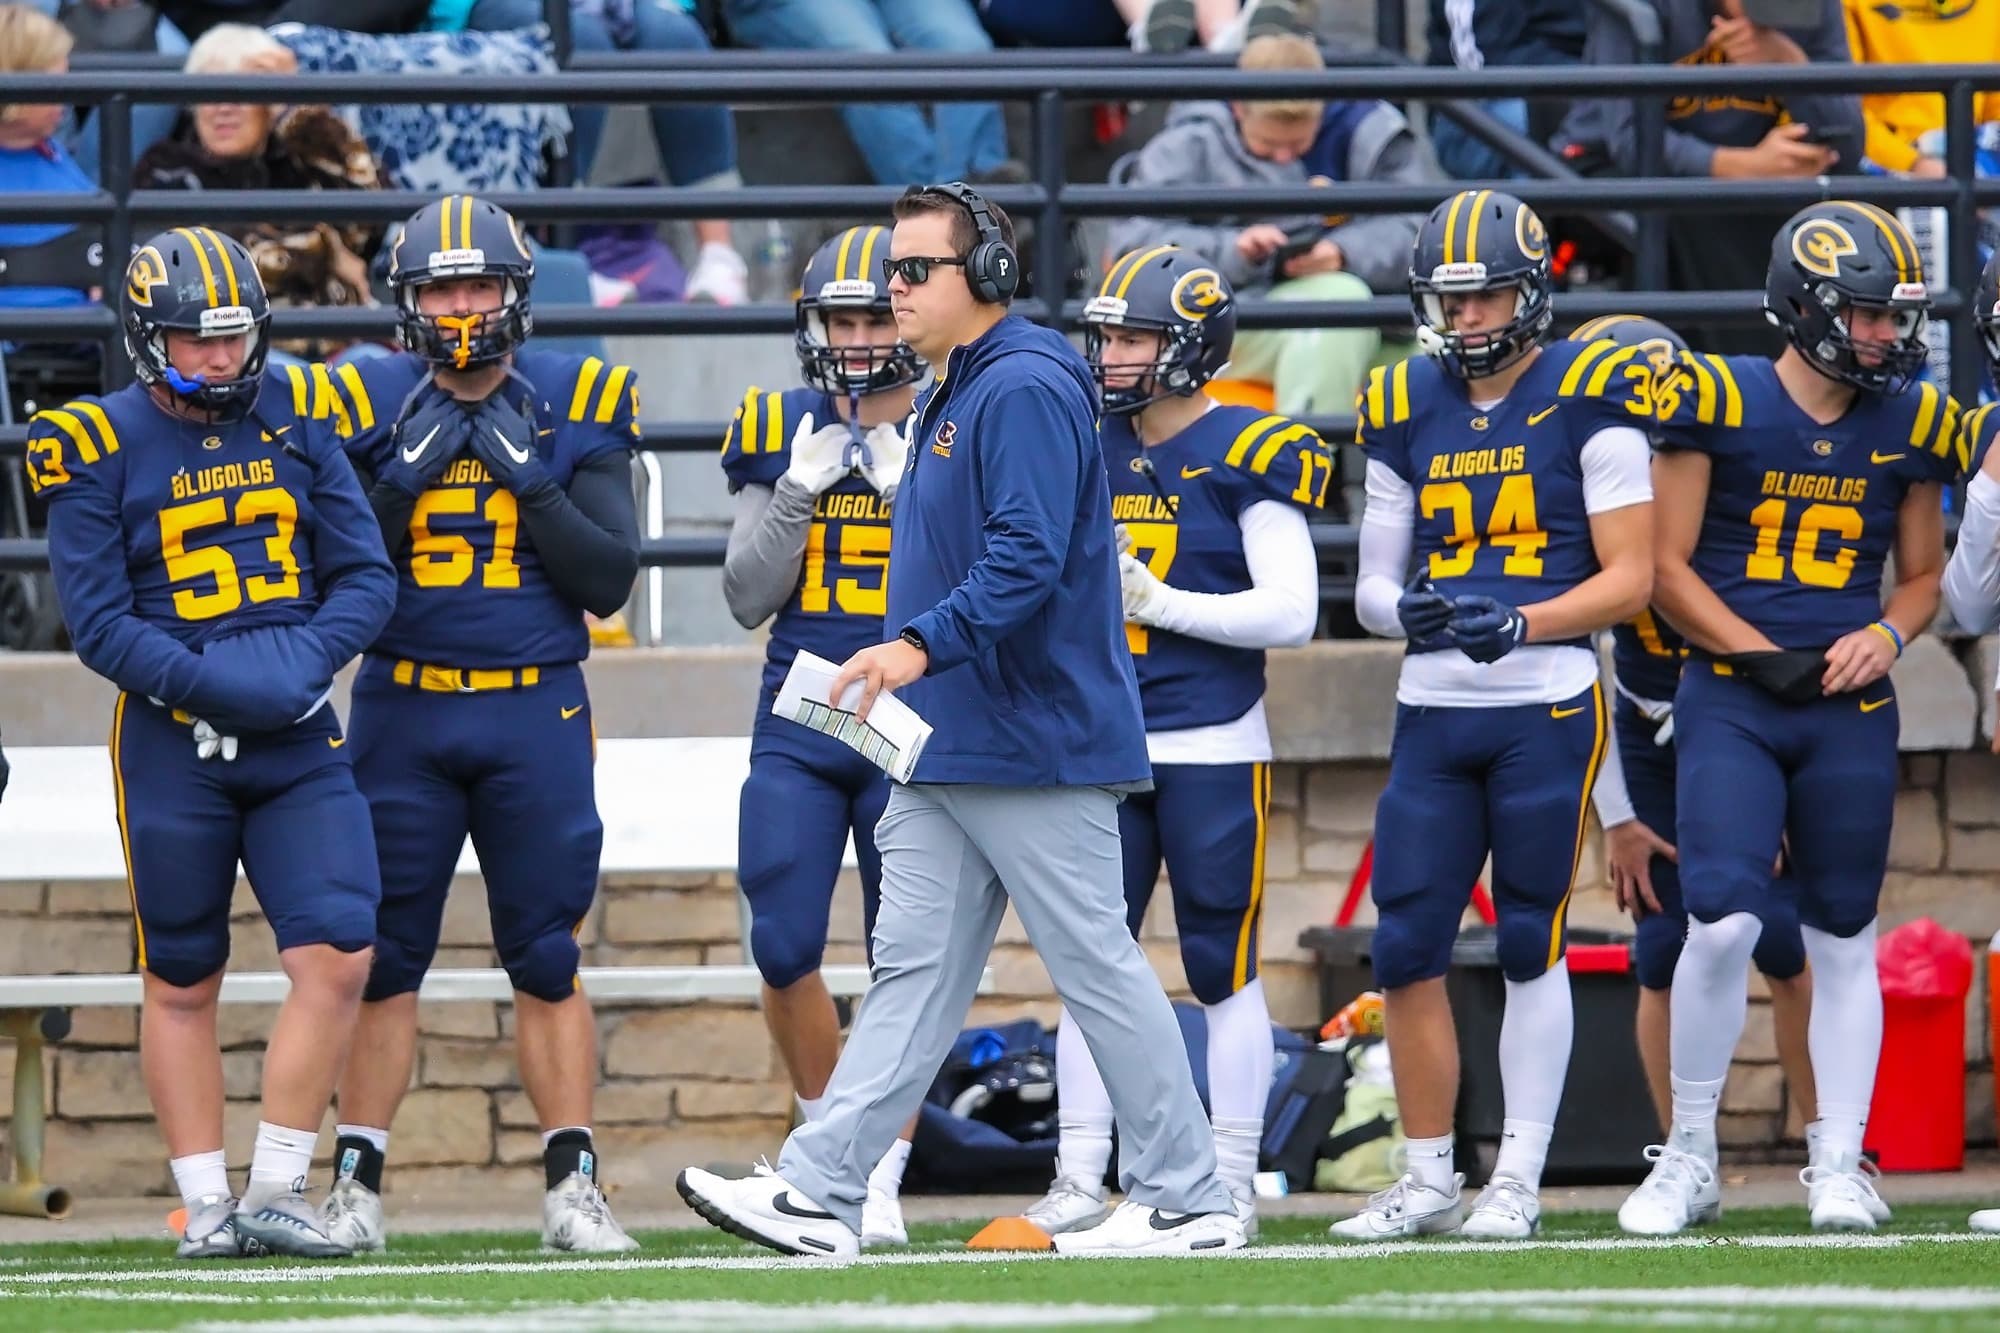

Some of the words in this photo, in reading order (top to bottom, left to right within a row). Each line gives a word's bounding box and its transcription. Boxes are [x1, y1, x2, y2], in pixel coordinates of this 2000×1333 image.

[998, 258, 1009, 276] P
[171, 458, 275, 499] BLUGOLDS
[1292, 448, 1332, 510] 17
[1428, 444, 1526, 479] BLUGOLDS
[1761, 470, 1868, 503] BLUGOLDS
[814, 494, 892, 519] LUGOLD
[1420, 473, 1548, 579] 34
[158, 486, 301, 621] 53
[409, 486, 521, 588] 51
[801, 522, 892, 616] 15
